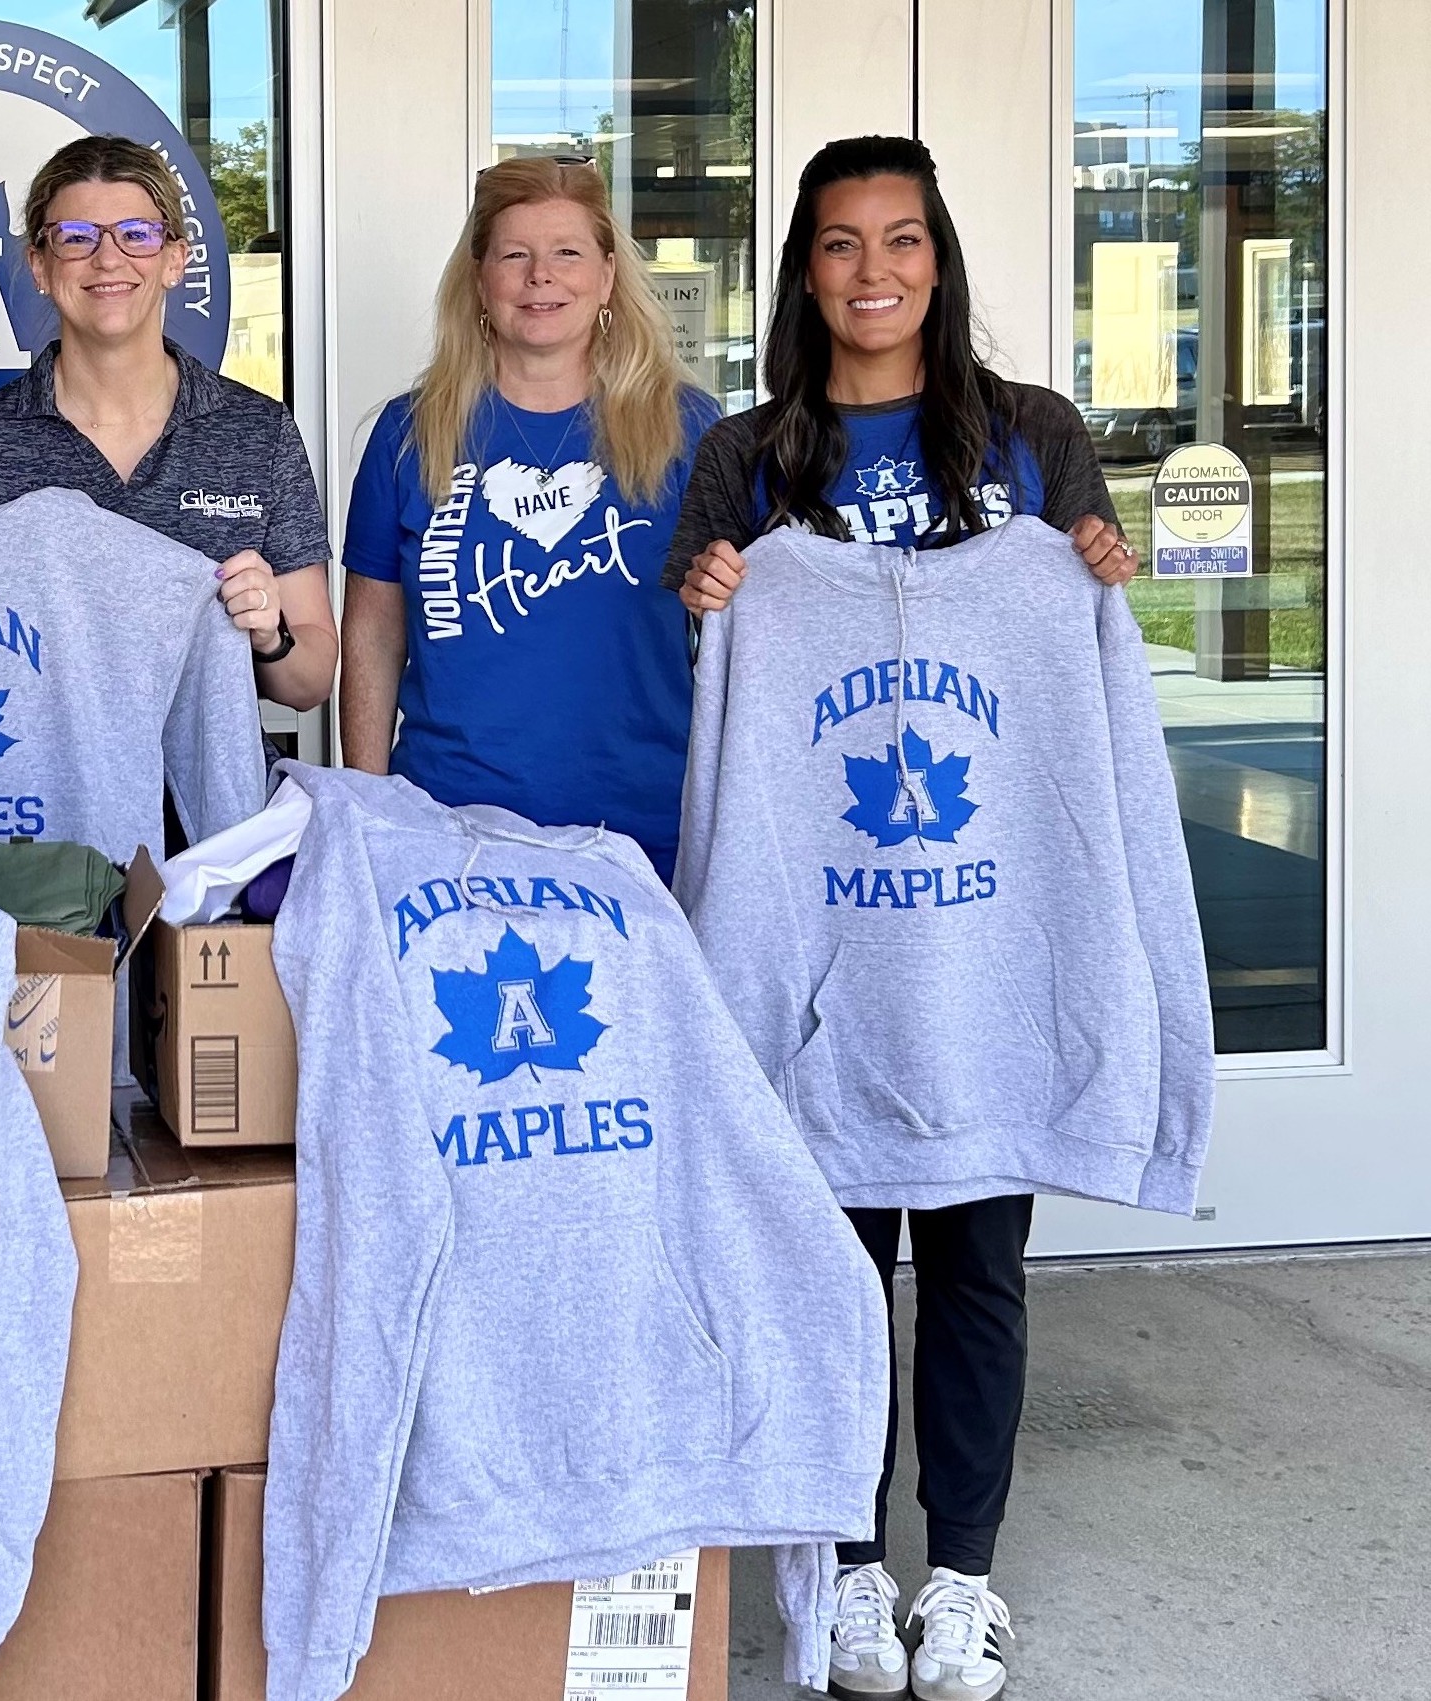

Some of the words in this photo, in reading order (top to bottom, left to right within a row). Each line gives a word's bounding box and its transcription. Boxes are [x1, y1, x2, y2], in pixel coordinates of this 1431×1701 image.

[1162, 466, 1242, 479] AUTOMATIC
[180, 488, 260, 509] Gleaner
[514, 485, 573, 518] HAVE
[1164, 486, 1240, 503] CAUTION
[1182, 510, 1222, 521] DOOR
[466, 505, 653, 635] Heart
[1161, 547, 1201, 561] ACTIVATE
[1210, 547, 1244, 560] SWITCH
[1174, 560, 1186, 574] TO
[1190, 560, 1228, 573] OPERATE
[811, 658, 1000, 747] ADRIAN
[888, 768, 940, 825] A
[823, 859, 997, 908] MAPLES
[393, 875, 630, 962] ADRIAN
[490, 978, 557, 1053] A
[431, 1097, 654, 1166] MAPLES
